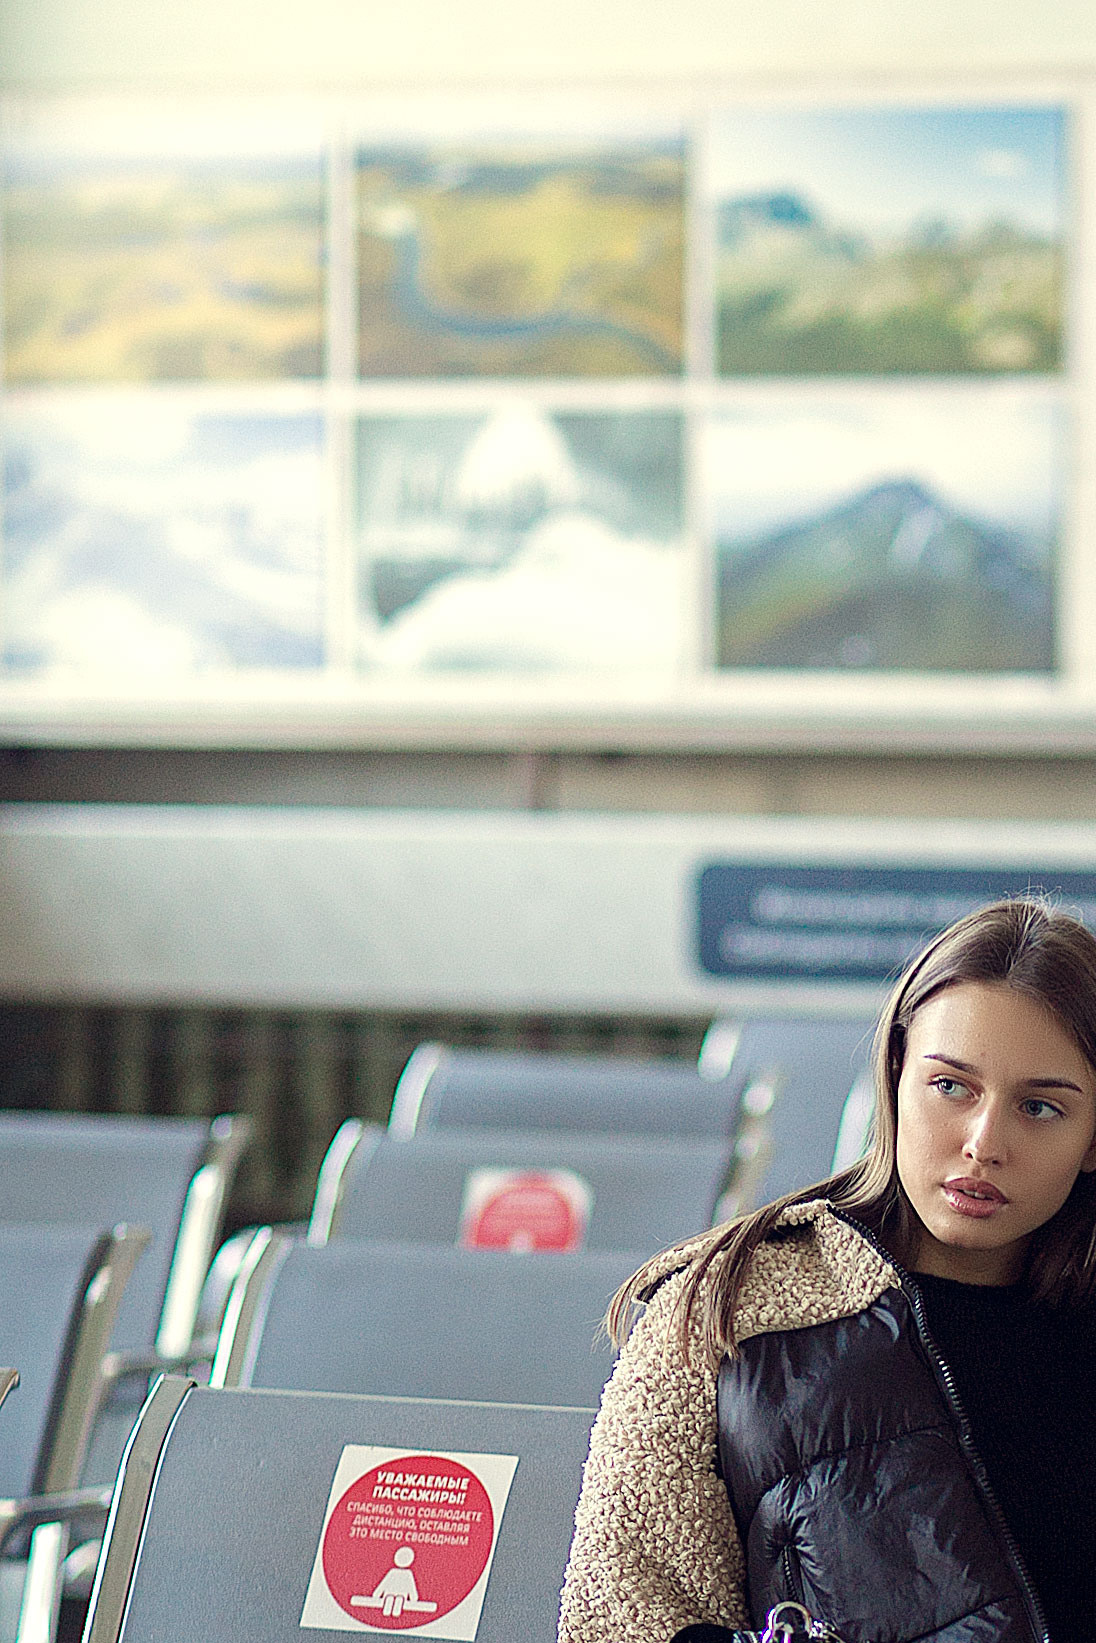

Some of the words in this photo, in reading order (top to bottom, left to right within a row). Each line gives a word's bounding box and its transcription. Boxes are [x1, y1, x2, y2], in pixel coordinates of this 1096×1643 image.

[376, 1471, 470, 1490] УВАЖАЕМЫЕ
[372, 1485, 466, 1505] ПАССАЖИРЫ!
[347, 1502, 394, 1516] СПАСИБО,
[397, 1506, 416, 1517] ЧТО
[417, 1507, 483, 1522] СОБЛЮДАЕТЕ
[352, 1514, 417, 1530] ДИСТАНЦИЮ,
[419, 1519, 470, 1533] ОСТАВЛЯЯ
[349, 1527, 367, 1538] ЭТО
[369, 1529, 403, 1541] МЕСТО
[405, 1531, 469, 1546] СВОБОДНЫМ
